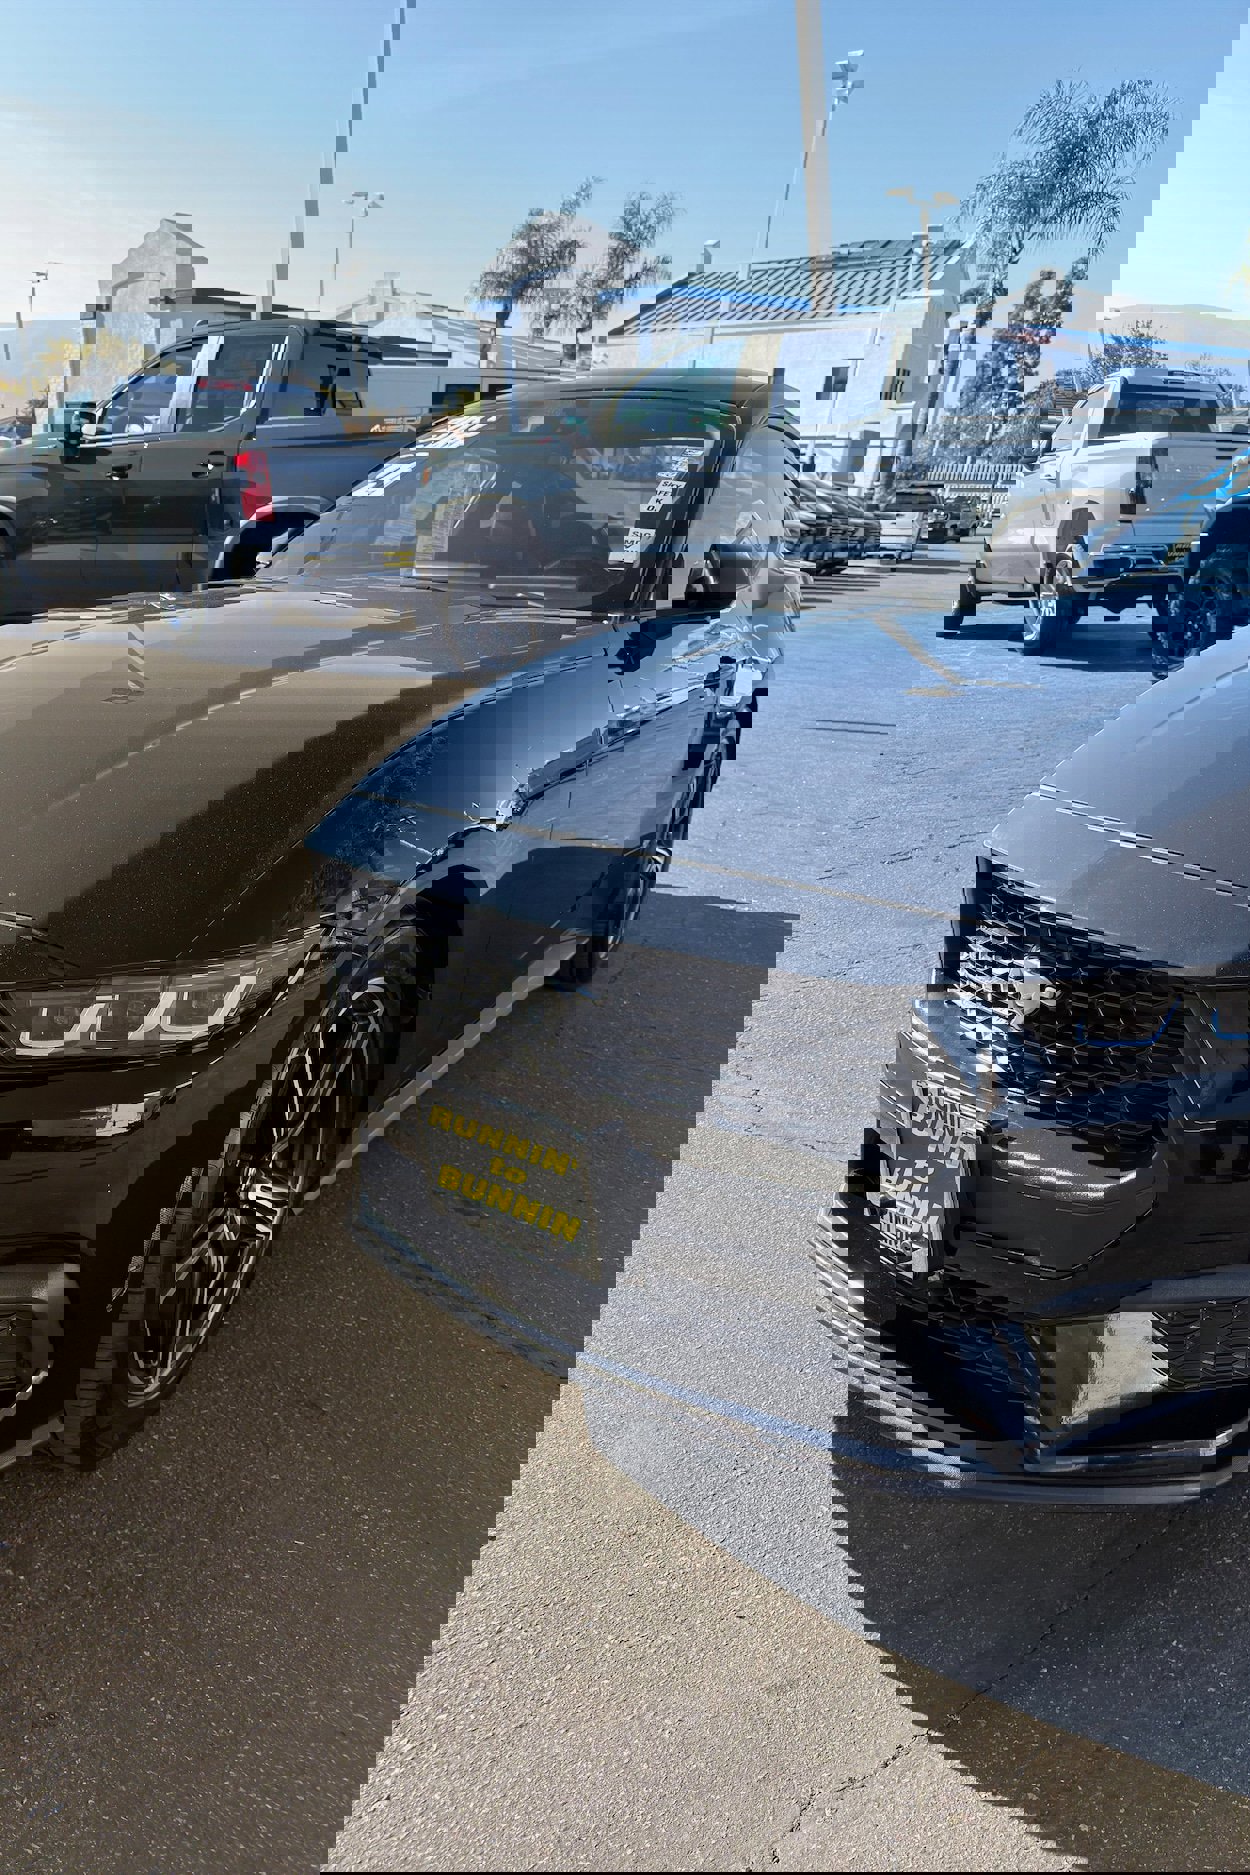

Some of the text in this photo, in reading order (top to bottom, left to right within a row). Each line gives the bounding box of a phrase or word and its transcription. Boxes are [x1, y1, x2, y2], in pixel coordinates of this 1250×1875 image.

[450, 1092, 531, 1140] BUNNIN
[489, 1156, 527, 1184] to
[437, 1164, 581, 1242] BUNNIN
